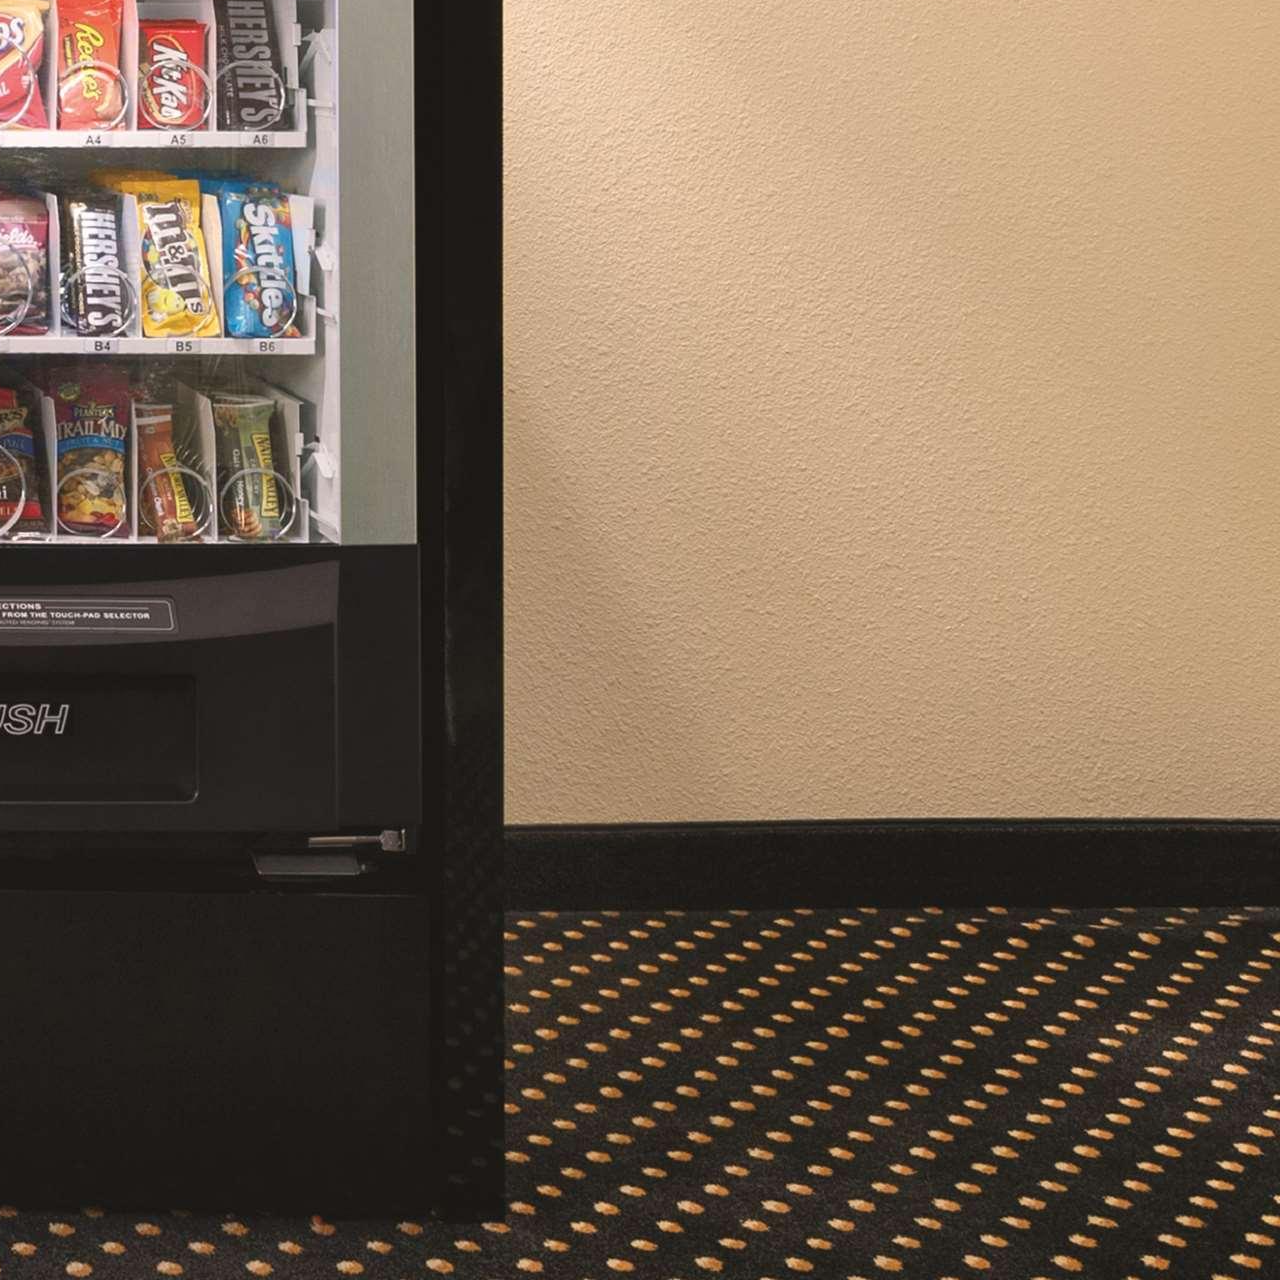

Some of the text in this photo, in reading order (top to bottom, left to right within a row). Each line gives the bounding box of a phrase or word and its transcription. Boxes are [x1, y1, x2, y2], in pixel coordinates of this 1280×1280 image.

[226, 0, 279, 122] HERSHEY'S
[85, 135, 102, 145] A4
[170, 135, 186, 145] A5
[252, 135, 269, 145] A6
[80, 211, 123, 328] HERSHEY'S
[243, 203, 288, 328] Skittles
[95, 341, 111, 351] B4
[176, 341, 193, 352] B5
[259, 341, 276, 352] B6
[57, 419, 99, 441] TRAIL
